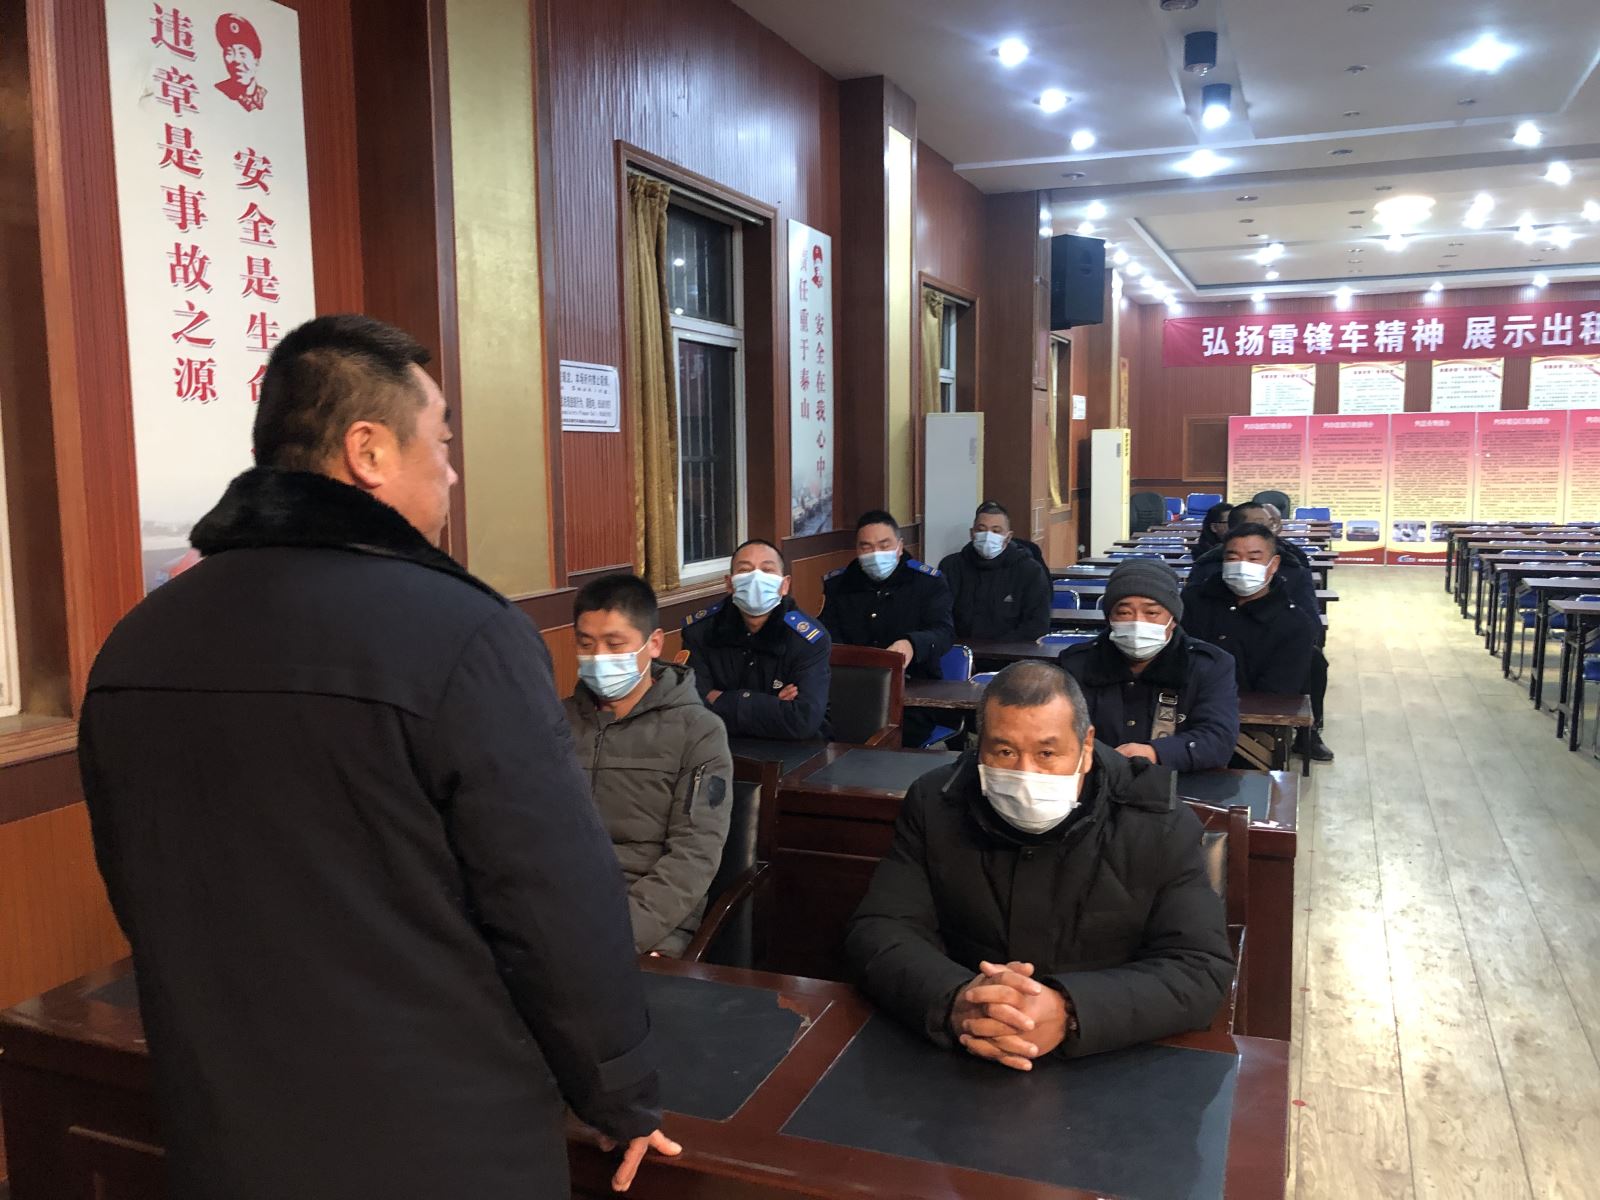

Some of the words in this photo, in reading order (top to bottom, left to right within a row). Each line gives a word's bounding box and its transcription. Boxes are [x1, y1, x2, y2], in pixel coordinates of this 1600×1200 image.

[149, 2, 217, 403] 违章是事故之源
[815, 313, 827, 477] 安全在我心中
[1201, 318, 1445, 357] 弘扬雷锋车精神
[1463, 310, 1600, 350] 展示出租
